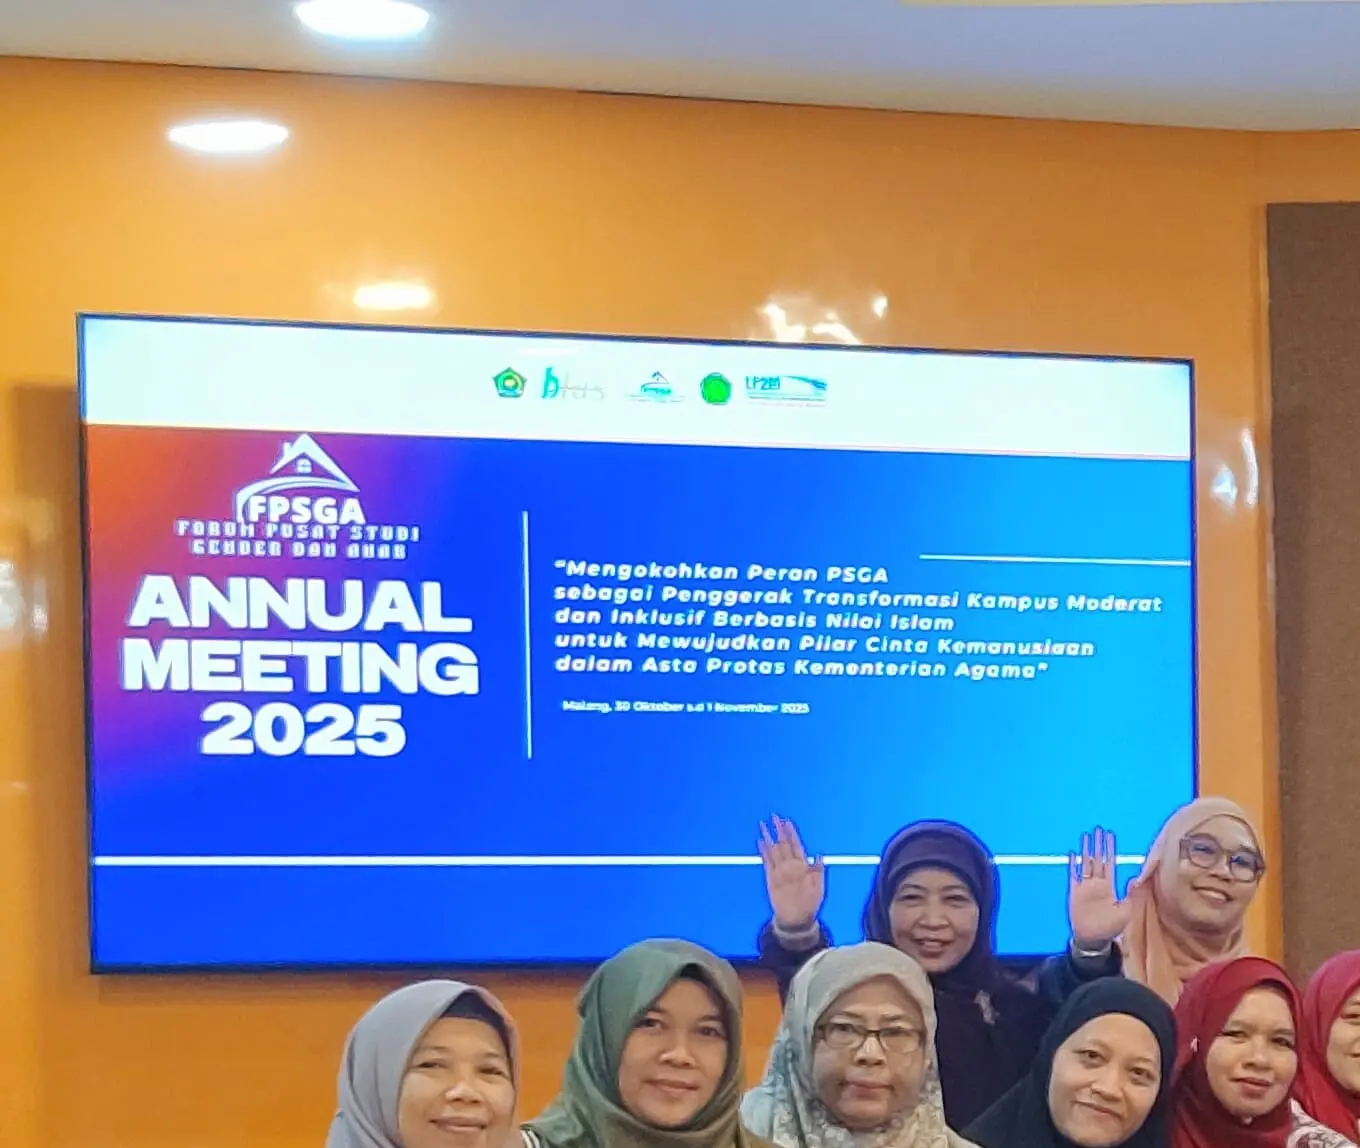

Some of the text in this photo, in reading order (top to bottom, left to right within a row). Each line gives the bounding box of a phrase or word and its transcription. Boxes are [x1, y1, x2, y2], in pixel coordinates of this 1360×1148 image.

[251, 495, 367, 525] FPSGA
[265, 524, 341, 540] PUSAT
[351, 526, 421, 542] STUDI
[747, 564, 818, 582] Peran
[826, 566, 889, 584] PSGA
[129, 575, 473, 633] ANNUAL
[554, 584, 1163, 612] sebagai Penggerak Transformasi Kampus Moderat
[555, 607, 955, 631] dan Inklusif Berbasis Nilai Islam
[554, 632, 1095, 656] untuk Mewujudkan Pilar Cinta Kemanusiaan
[123, 638, 479, 695] MEETING
[555, 654, 633, 673] dalam
[641, 657, 698, 674] Asta
[706, 657, 786, 675] Protas
[794, 658, 946, 678] Kementerian
[200, 702, 406, 757] 2025
